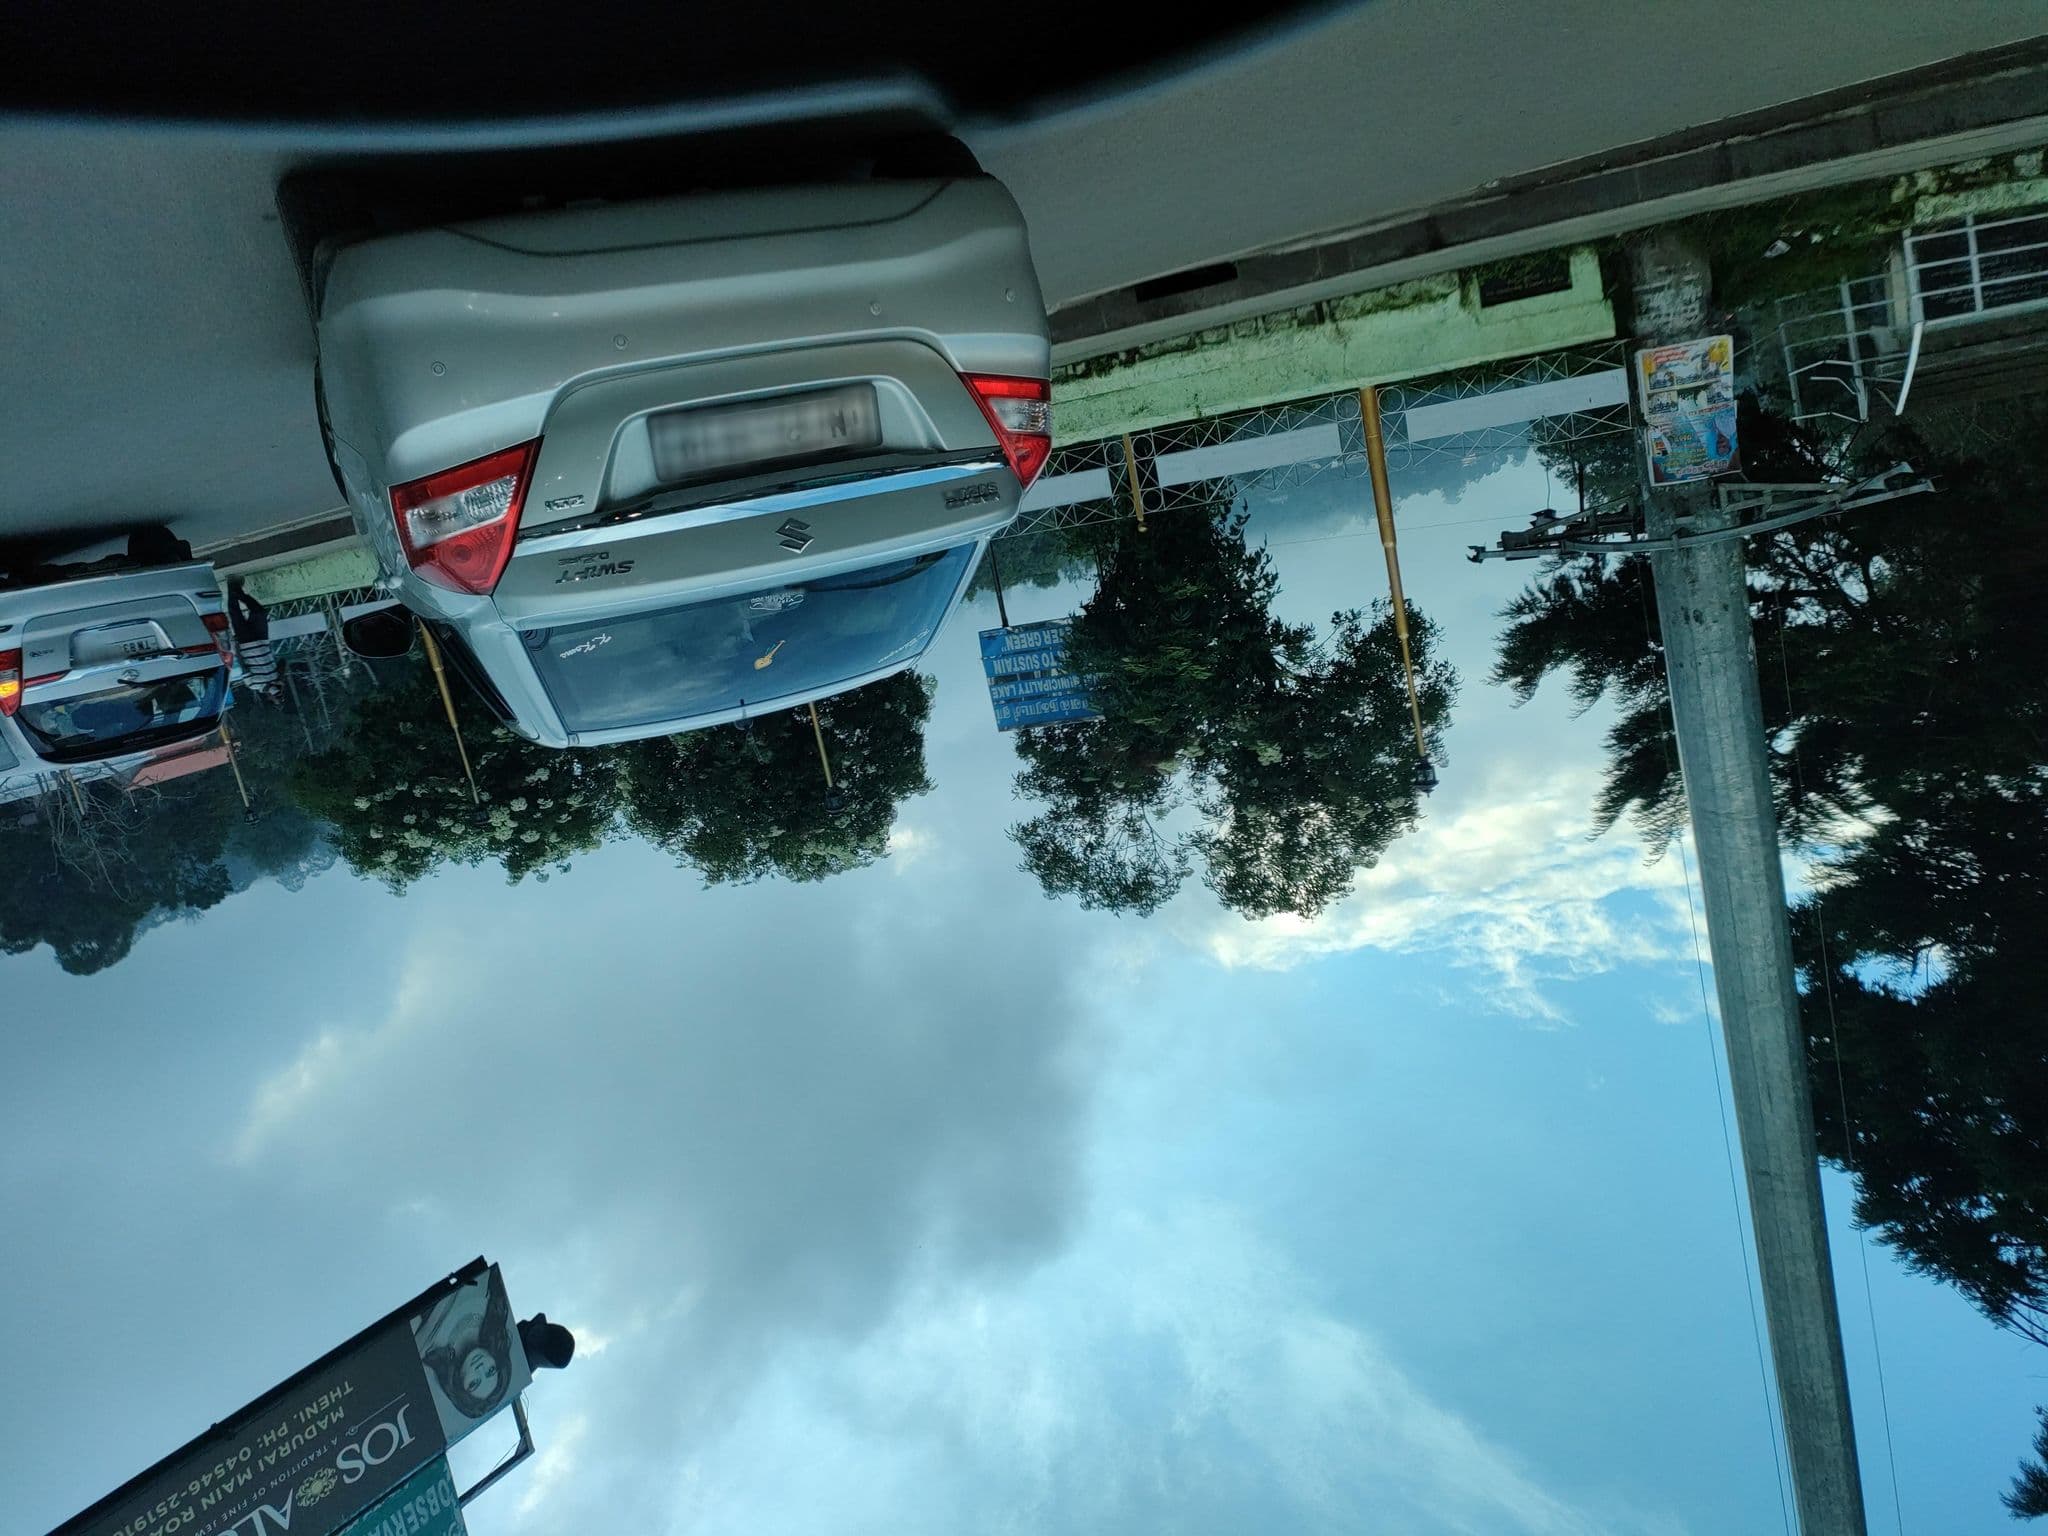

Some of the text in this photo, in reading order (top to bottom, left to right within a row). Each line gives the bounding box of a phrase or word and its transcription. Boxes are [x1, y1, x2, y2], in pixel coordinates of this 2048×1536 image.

[555, 560, 635, 584] SWIFT
[992, 654, 1039, 674] SUSTAIN
[1041, 651, 1057, 668] TO
[991, 684, 1017, 698] LAKE
[293, 1380, 354, 1421] THENI.
[256, 1421, 289, 1449] PH:
[257, 1405, 345, 1472] MADURAI
[330, 1436, 338, 1446] A
[216, 1402, 415, 1536] JOS AL
[270, 1444, 328, 1488] TRADITION
[200, 1466, 252, 1509] MAIN
[251, 1486, 266, 1500] OF
[220, 1498, 248, 1521] FINE
